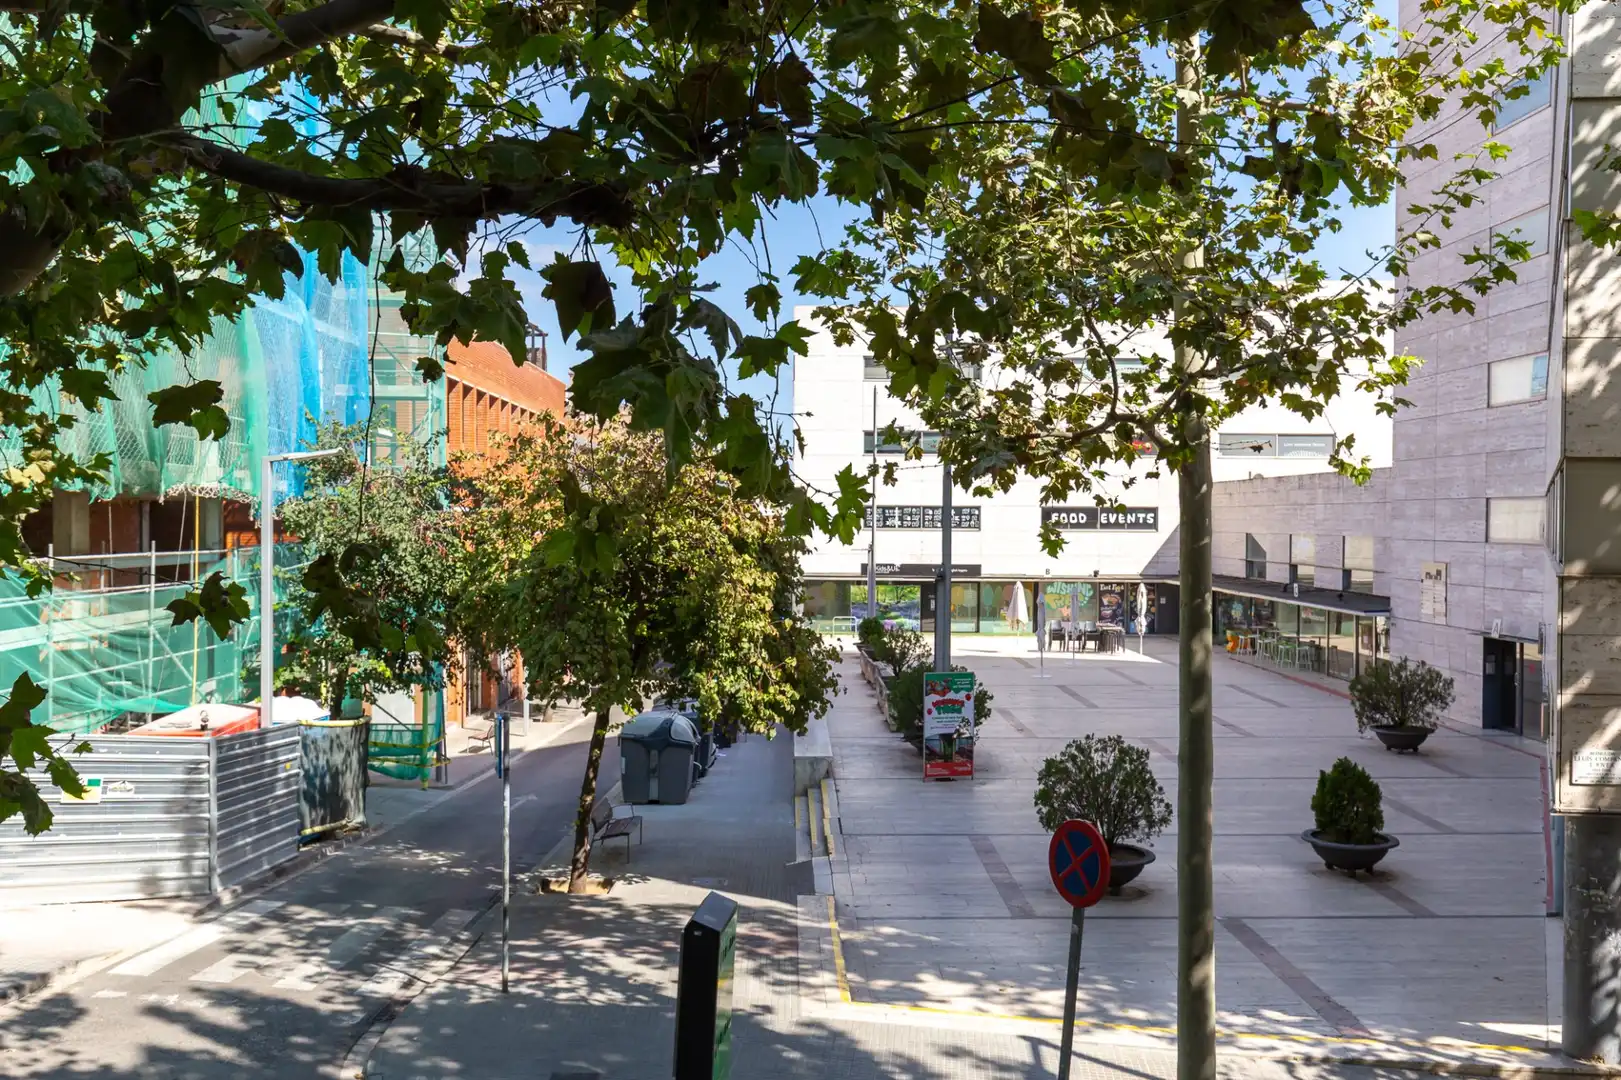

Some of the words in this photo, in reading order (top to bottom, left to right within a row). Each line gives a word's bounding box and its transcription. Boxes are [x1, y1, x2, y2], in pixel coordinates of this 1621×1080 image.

[1051, 512, 1087, 524] FOOD
[1100, 512, 1155, 524] EVENTS
[1493, 622, 1499, 634] A
